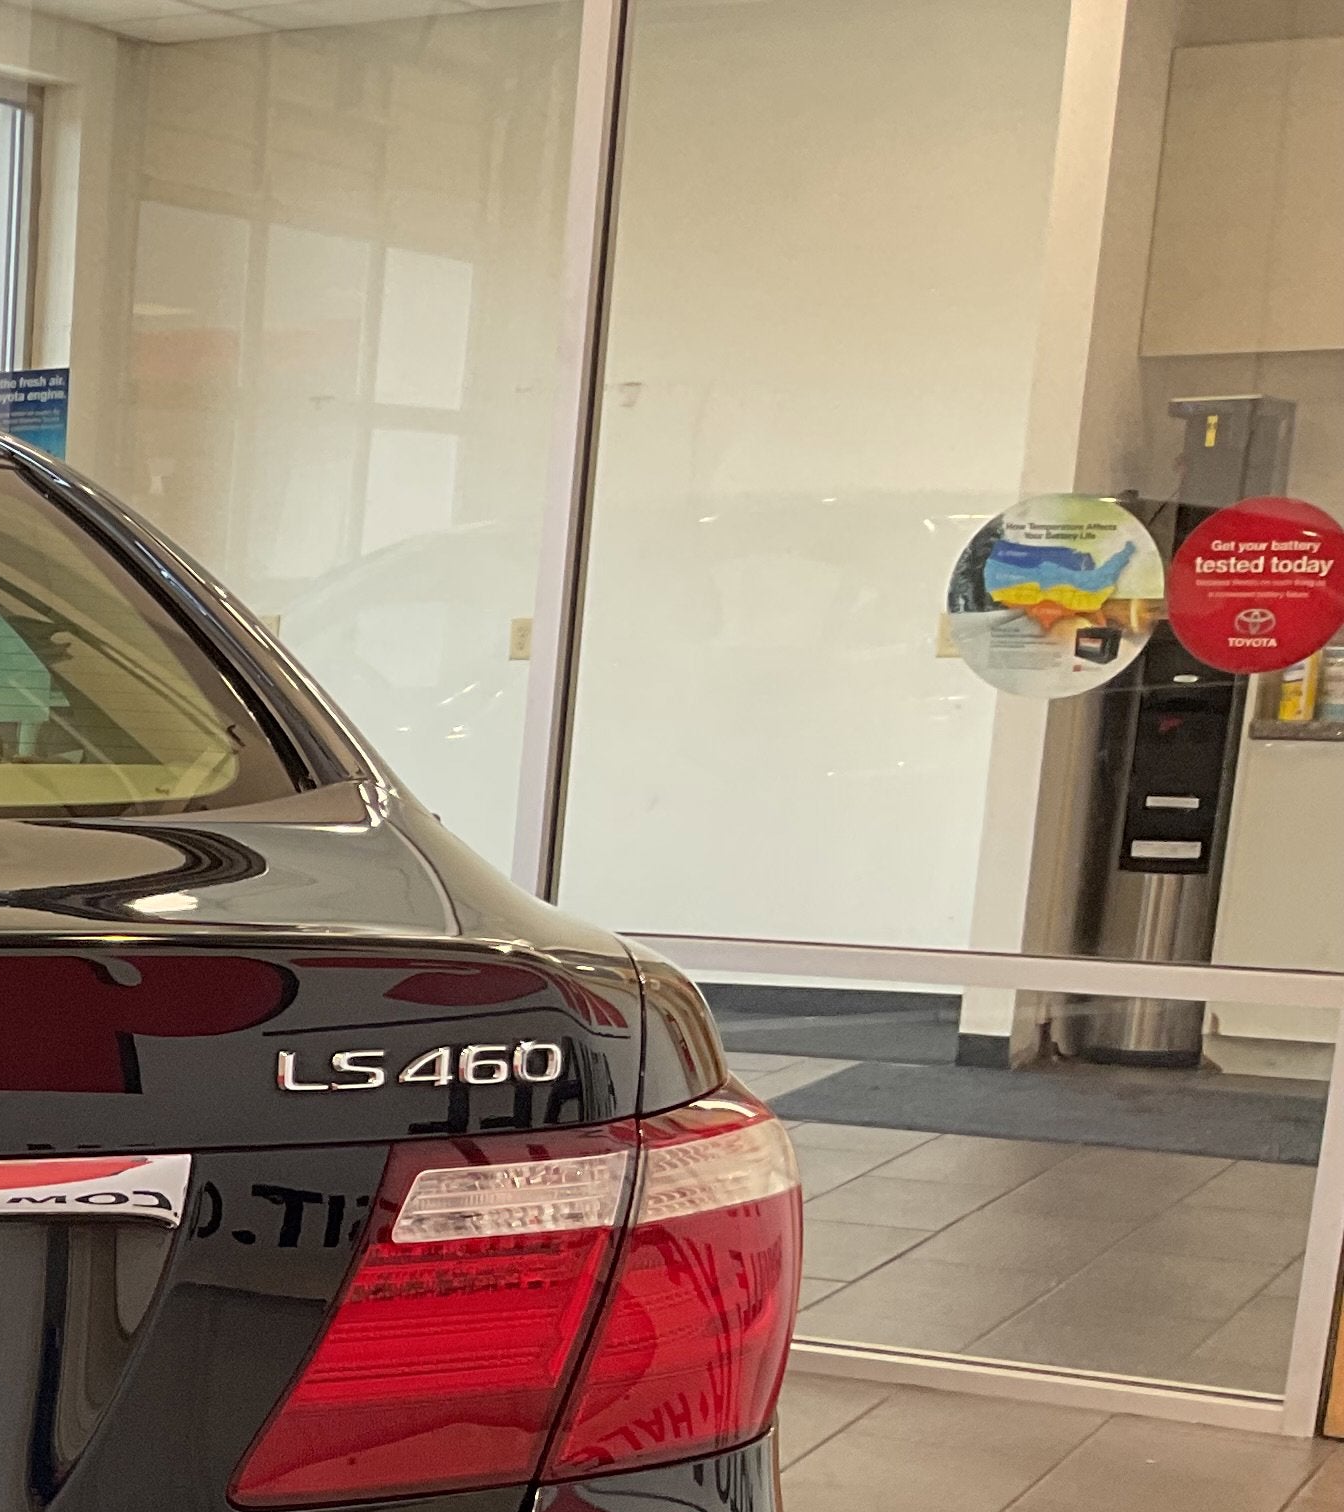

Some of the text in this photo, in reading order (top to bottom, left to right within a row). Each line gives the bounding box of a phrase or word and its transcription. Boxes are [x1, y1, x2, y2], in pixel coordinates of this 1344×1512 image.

[19, 376, 47, 388] fresh
[1211, 540, 1323, 554] Get your battery
[1194, 555, 1335, 578] tested today
[1227, 637, 1278, 648] TOYOTA
[277, 1040, 563, 1091] LS 460
